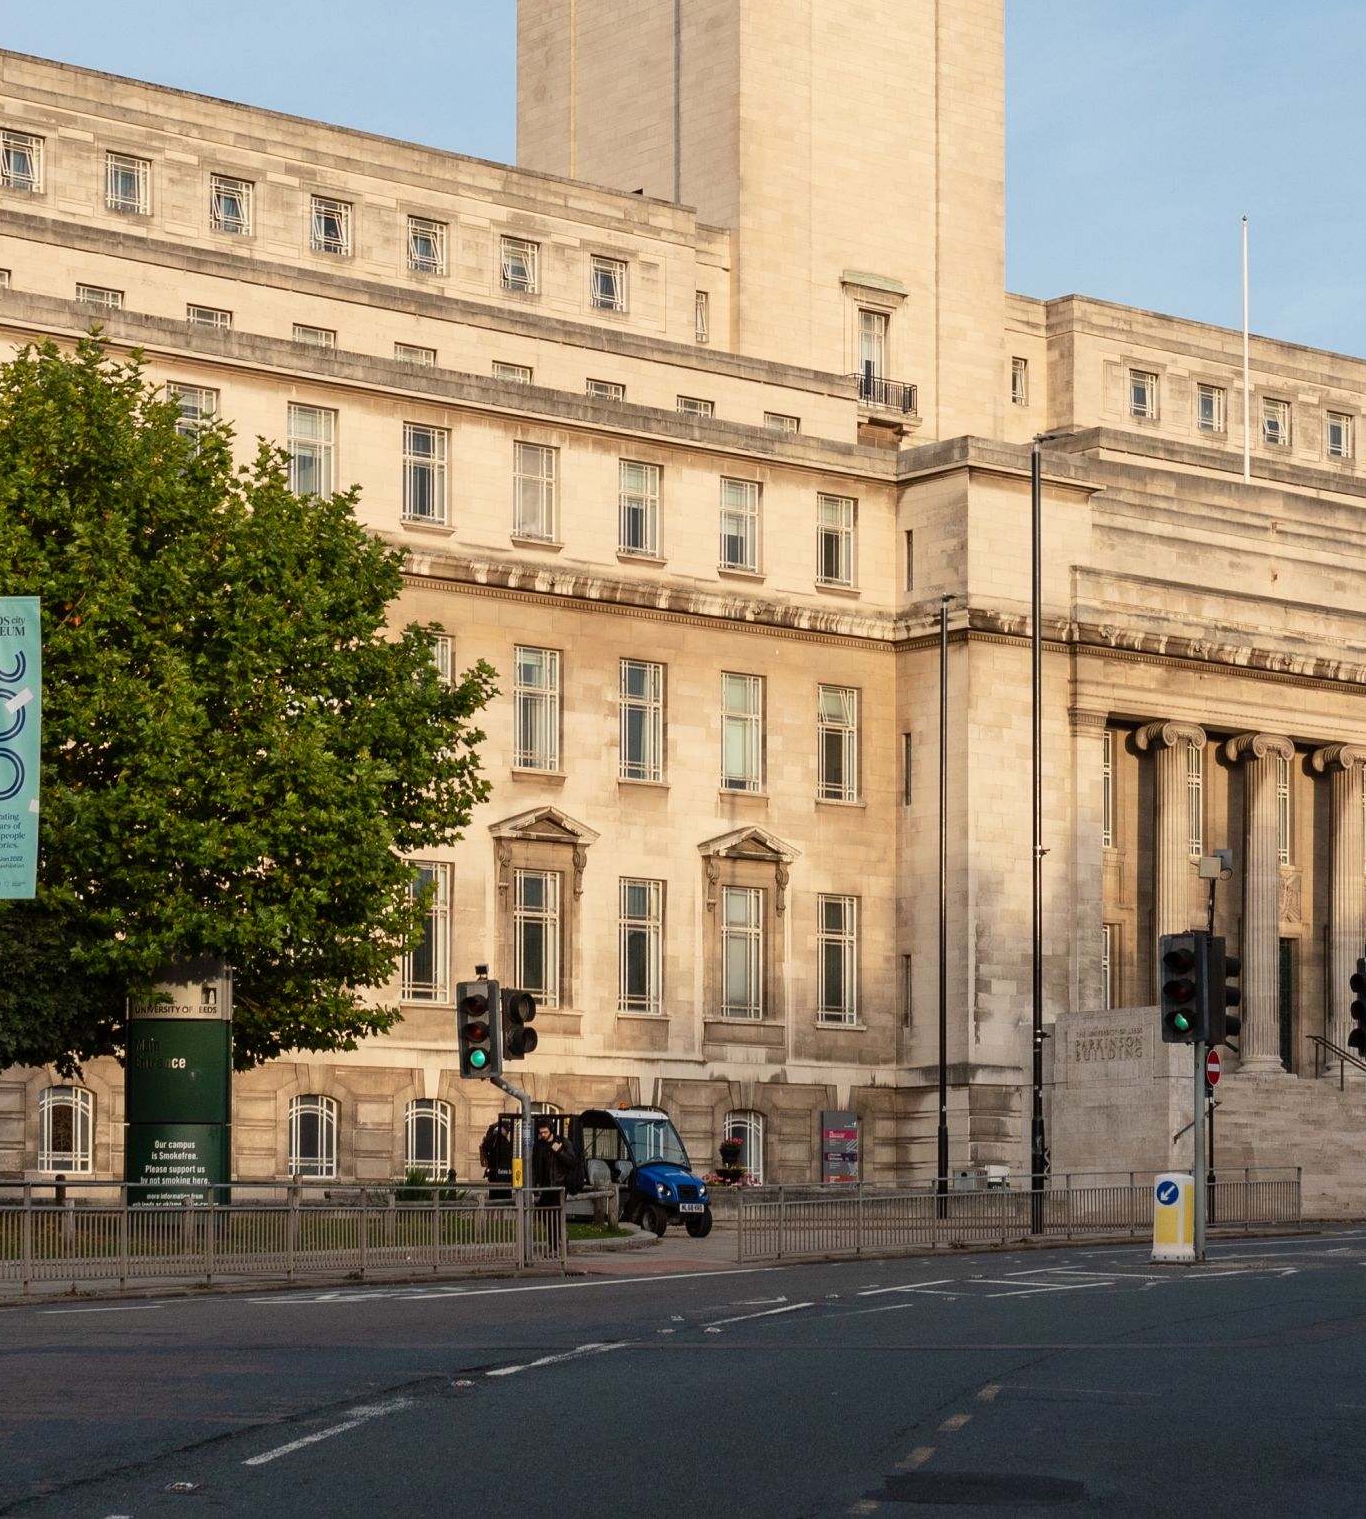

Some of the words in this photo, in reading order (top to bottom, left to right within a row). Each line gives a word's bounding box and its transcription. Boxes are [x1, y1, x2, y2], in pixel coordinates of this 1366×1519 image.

[11, 616, 26, 626] city
[13, 822, 21, 830] of
[0, 831, 26, 841] people
[135, 1005, 181, 1014] UNIVERSITY
[182, 1006, 194, 1014] OF
[198, 1006, 217, 1014] EEDS
[1076, 1035, 1143, 1050] PARKINSON
[1076, 1047, 1143, 1061] BUILDING
[155, 1140, 167, 1149] Our
[168, 1141, 195, 1150] campus
[151, 1152, 157, 1160] is
[159, 1152, 198, 1160] Smokefree.
[145, 1165, 167, 1173] Please
[169, 1165, 195, 1173] support
[162, 1176, 190, 1184] smoking
[192, 1177, 211, 1185] here.
